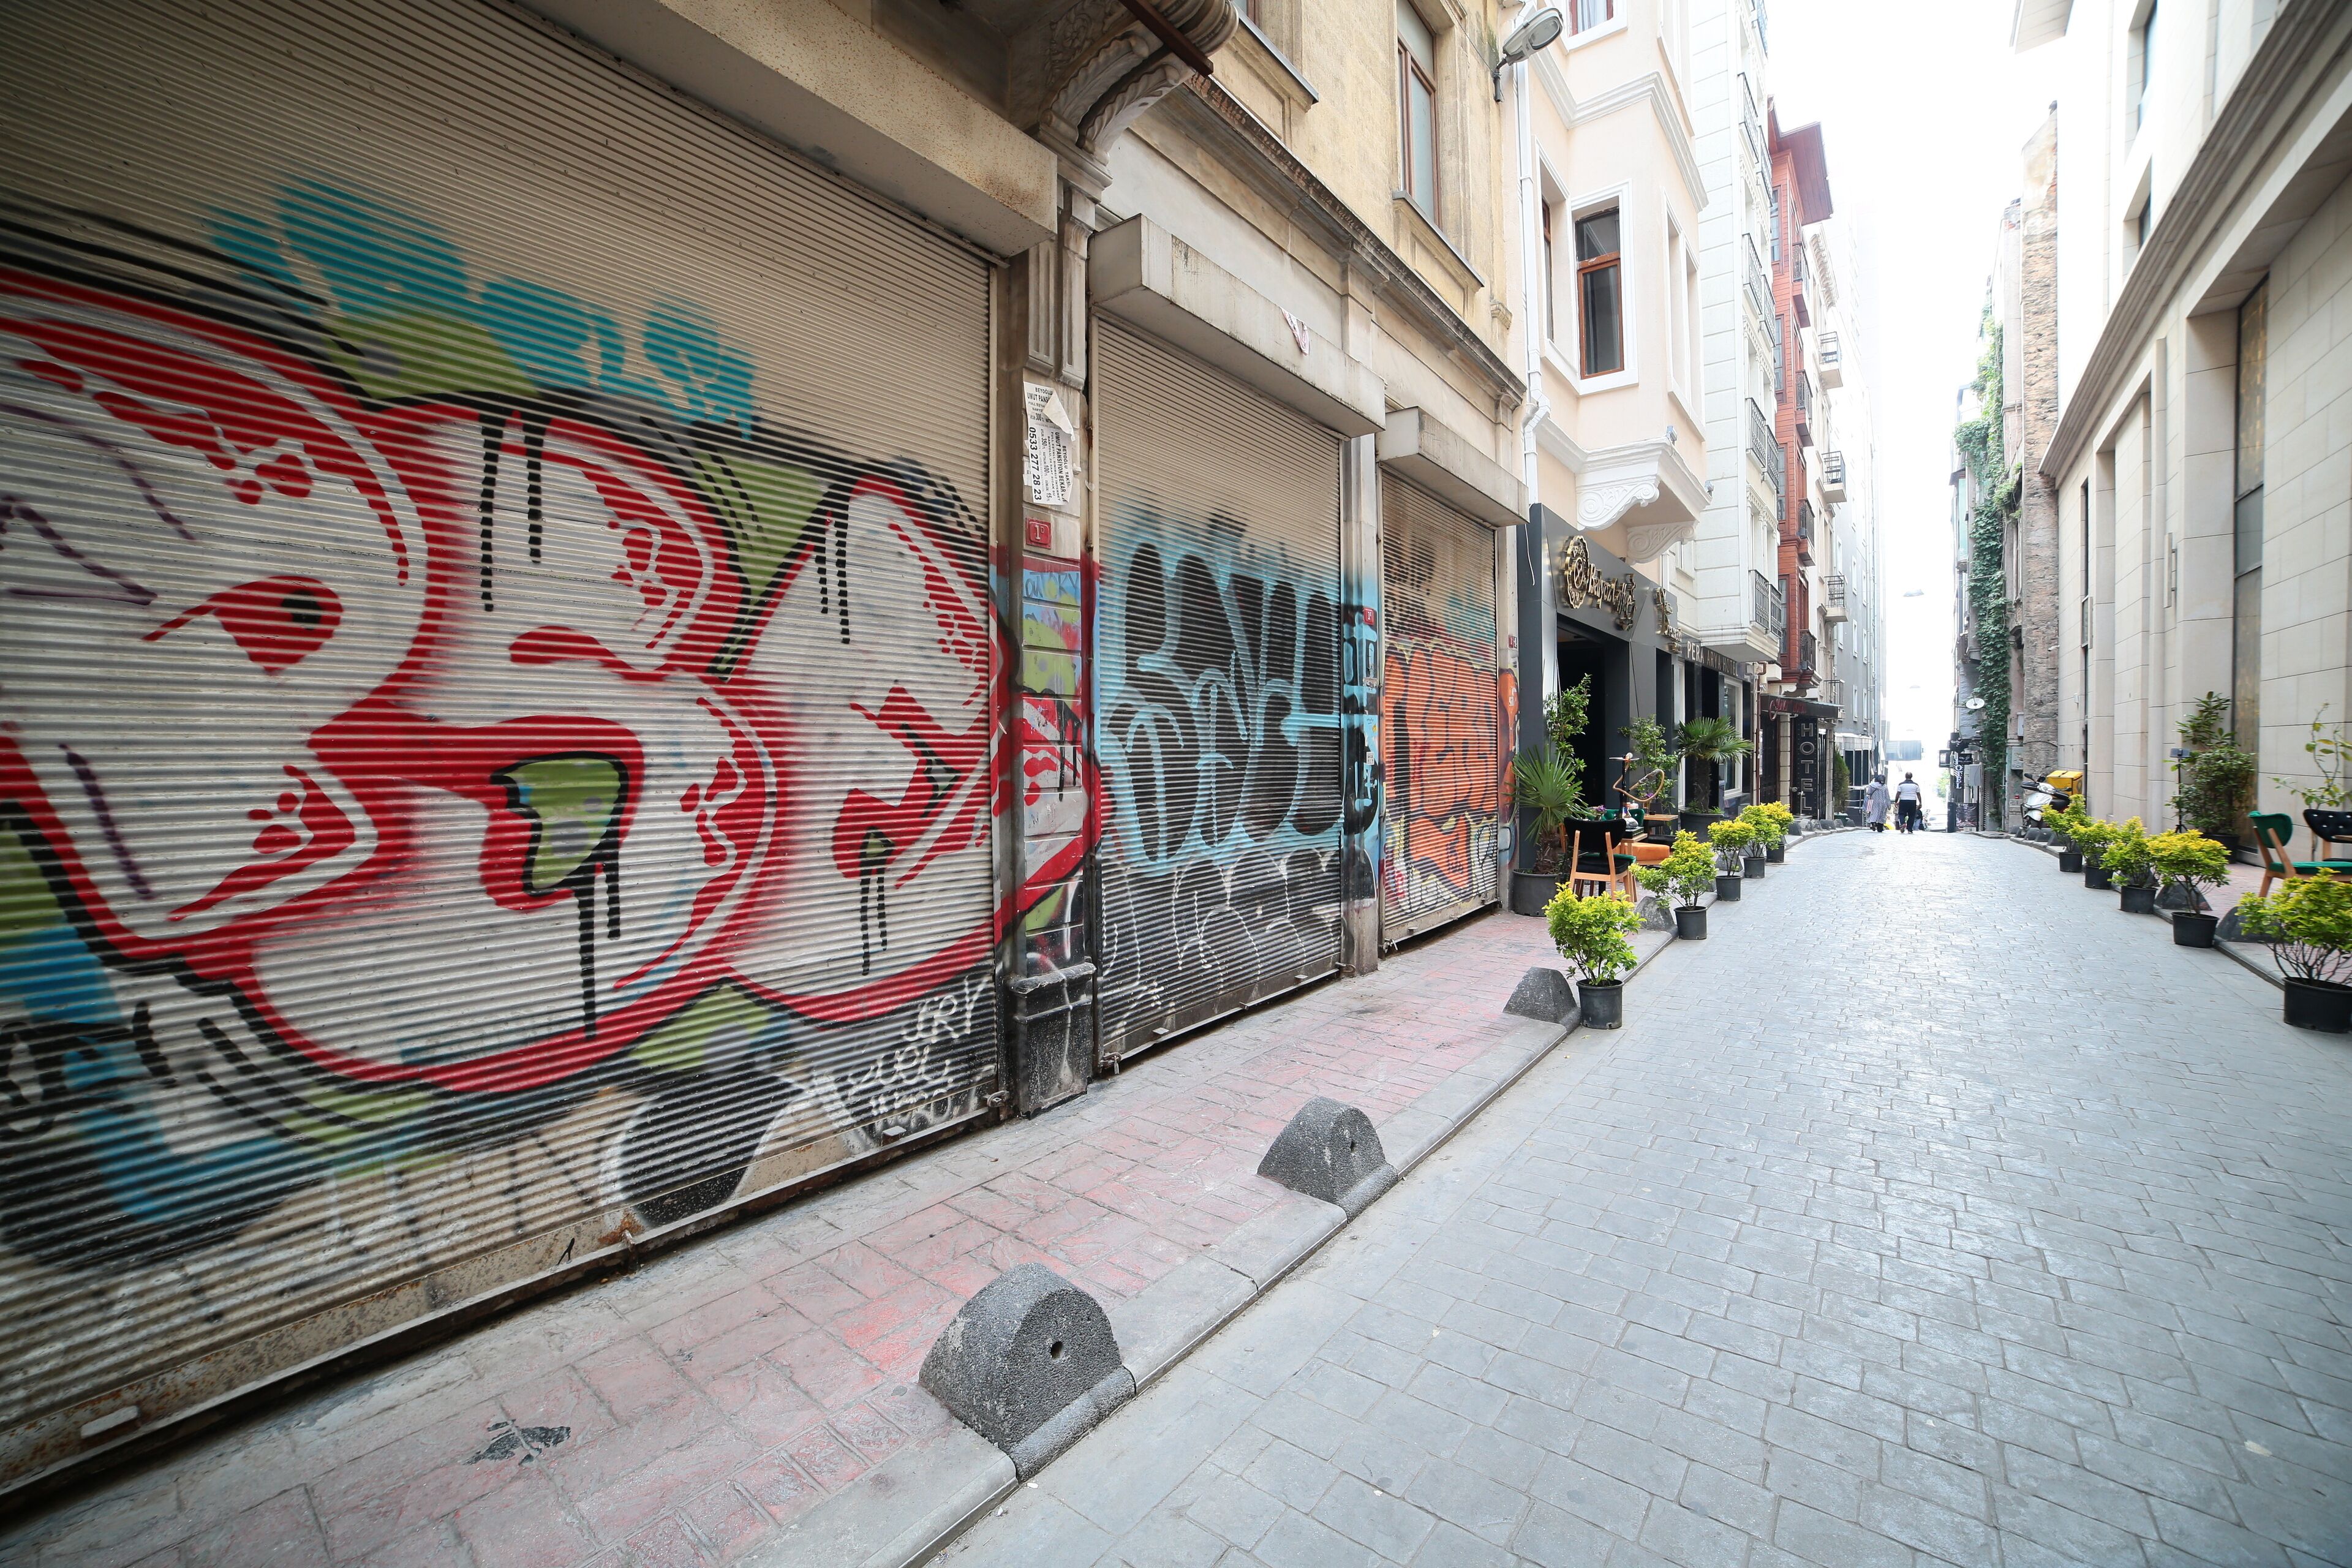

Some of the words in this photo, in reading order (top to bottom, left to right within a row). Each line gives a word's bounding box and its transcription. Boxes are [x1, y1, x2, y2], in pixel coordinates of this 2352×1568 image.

[1033, 474, 1041, 485] 28
[1034, 489, 1041, 500] 23
[1687, 641, 1704, 664] PERA
[1706, 649, 1721, 671] ARYA
[1722, 657, 1738, 676] HOTEL
[1800, 723, 1815, 812] HOTEL
